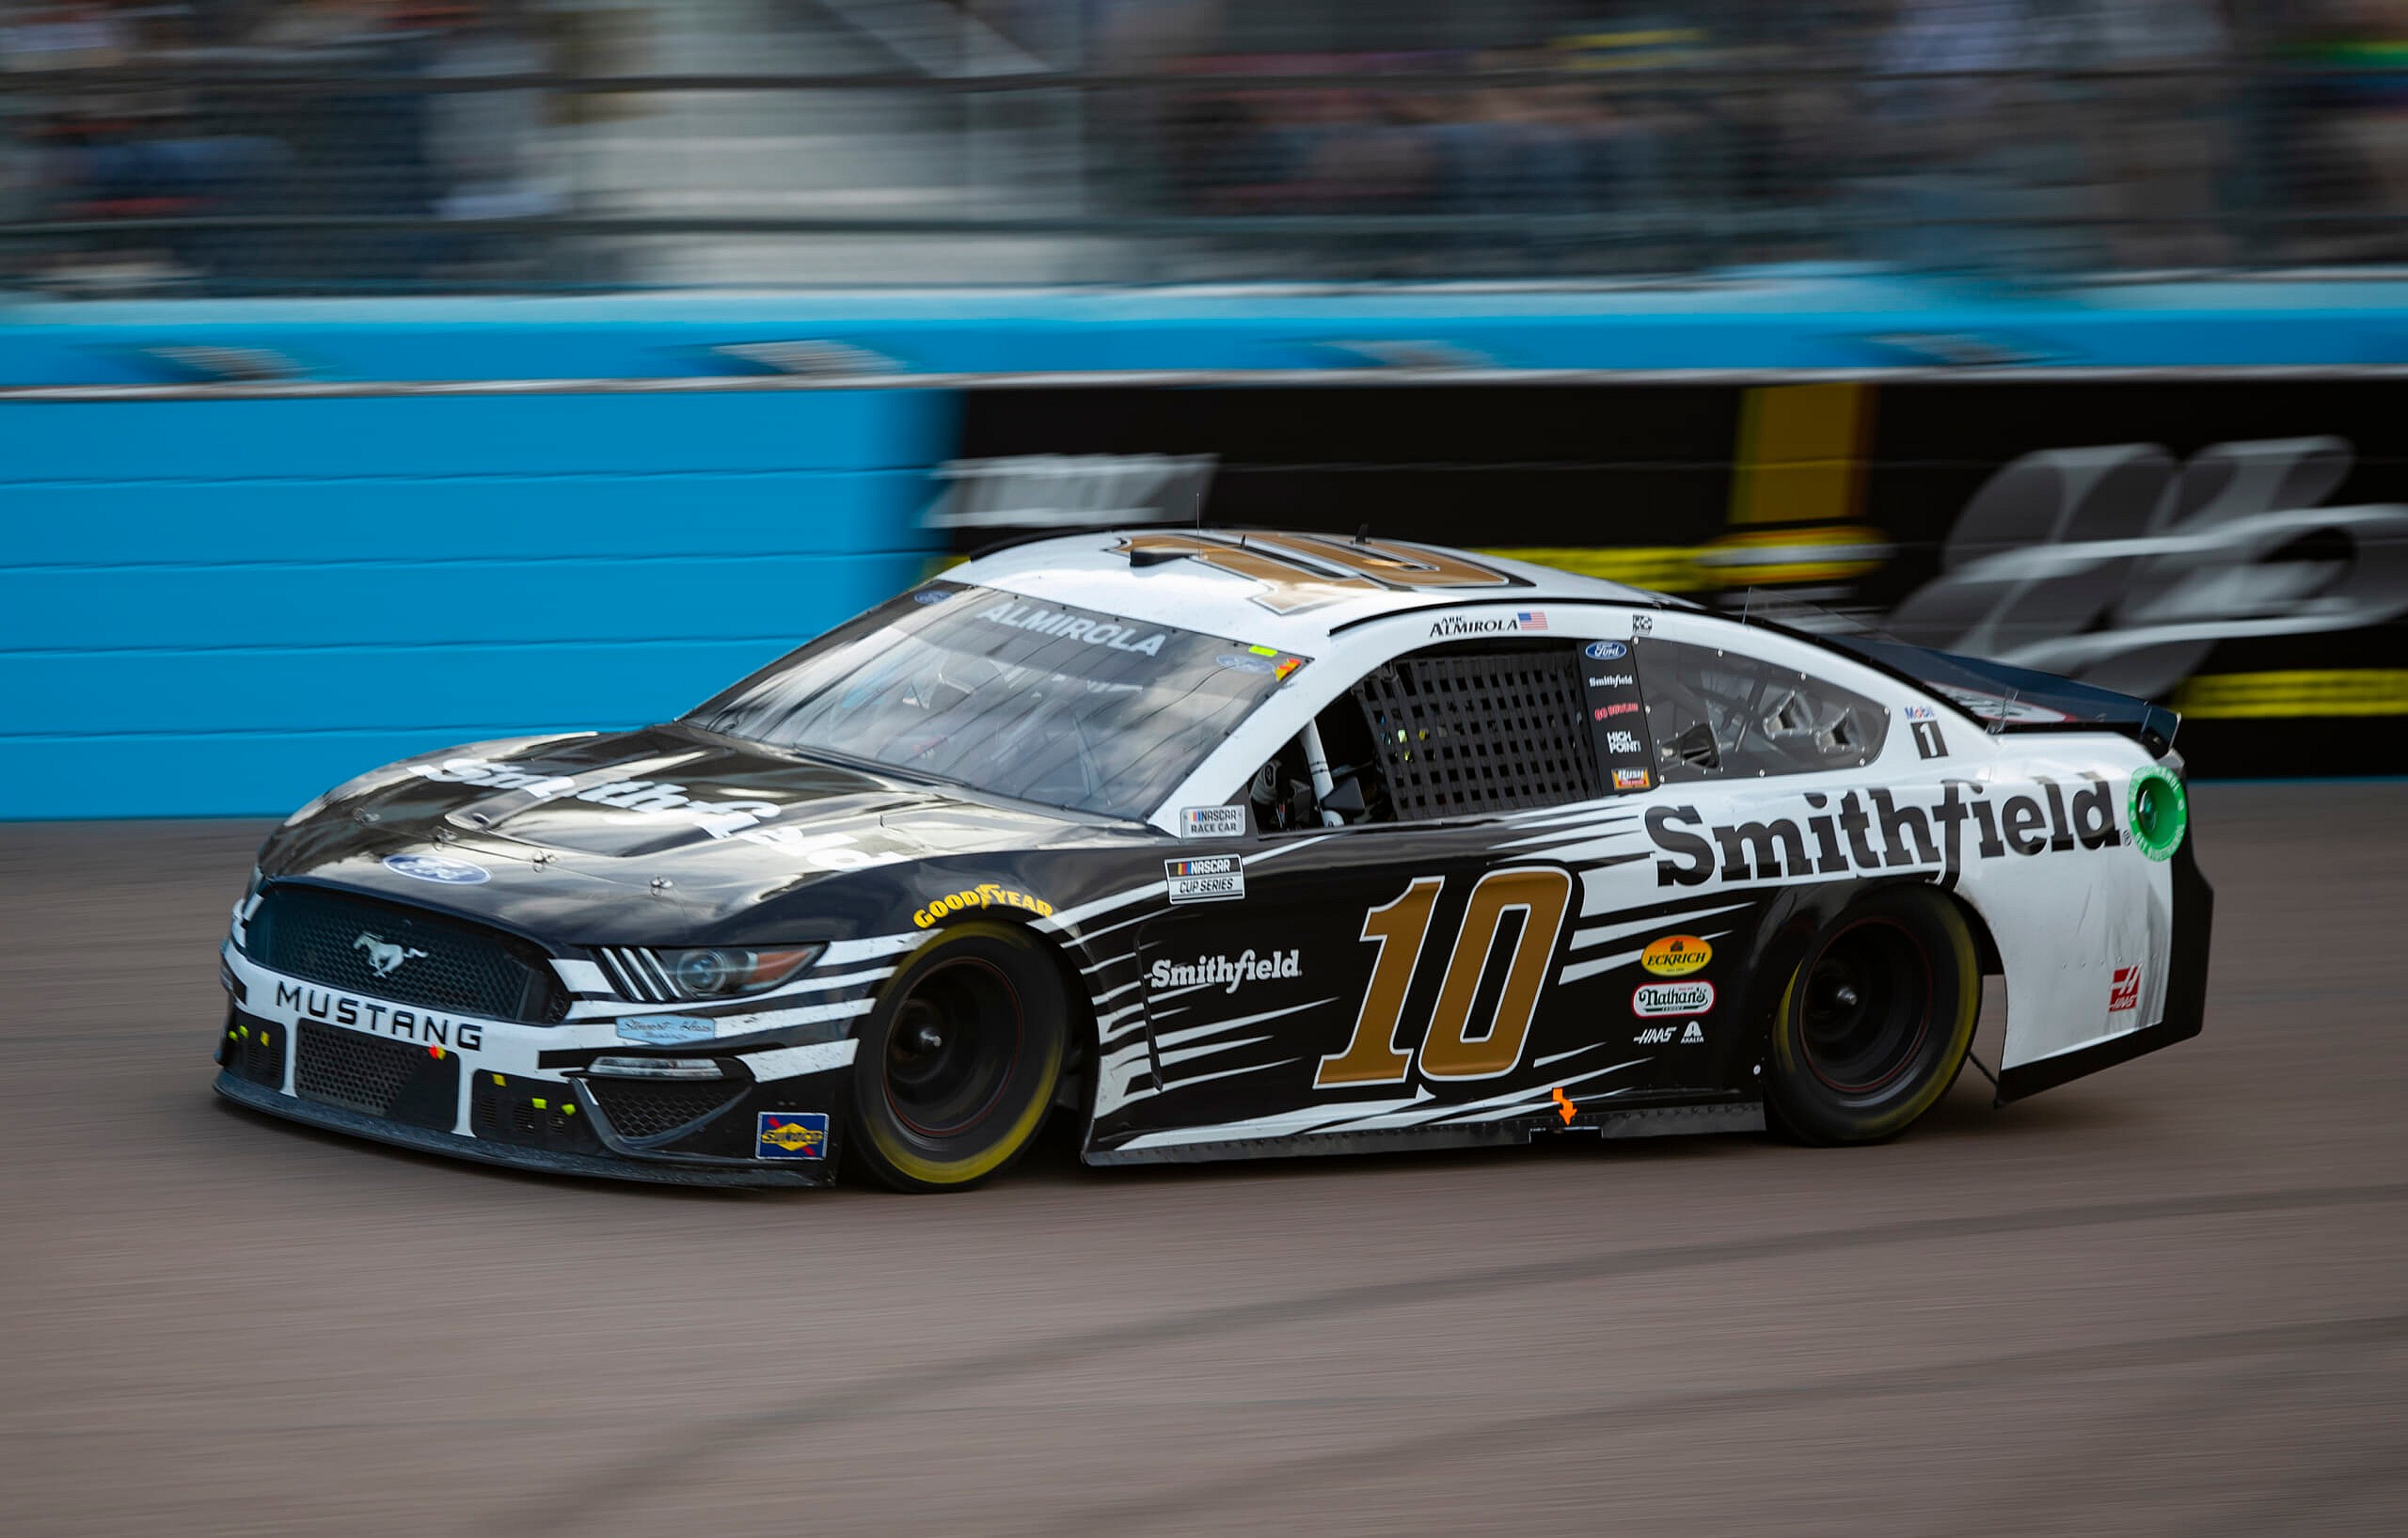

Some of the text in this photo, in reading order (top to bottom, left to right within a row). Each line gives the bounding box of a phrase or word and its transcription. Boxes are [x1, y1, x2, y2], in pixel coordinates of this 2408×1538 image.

[976, 601, 1166, 657] ALMIROLA
[1429, 619, 1517, 638] ALMIROLA
[1594, 642, 1619, 658] Ford
[1608, 730, 1632, 745] HIGH
[1920, 722, 1938, 757] 1
[1201, 810, 1237, 821] NASCAR
[1191, 822, 1237, 833] RACE CAR
[1644, 770, 2121, 893] Smithfield
[1191, 859, 1230, 875] NASCAR
[1180, 878, 1233, 894] CUP SERIES
[912, 884, 1054, 929] GOODYEAR
[1647, 951, 1706, 966] ECKRICH
[1151, 949, 1299, 994] Smithfield
[1312, 865, 1573, 1089] 10
[1638, 986, 1708, 1007] Nathan's
[276, 980, 483, 1052] MUSTANG
[1633, 1026, 1677, 1044] HAAS
